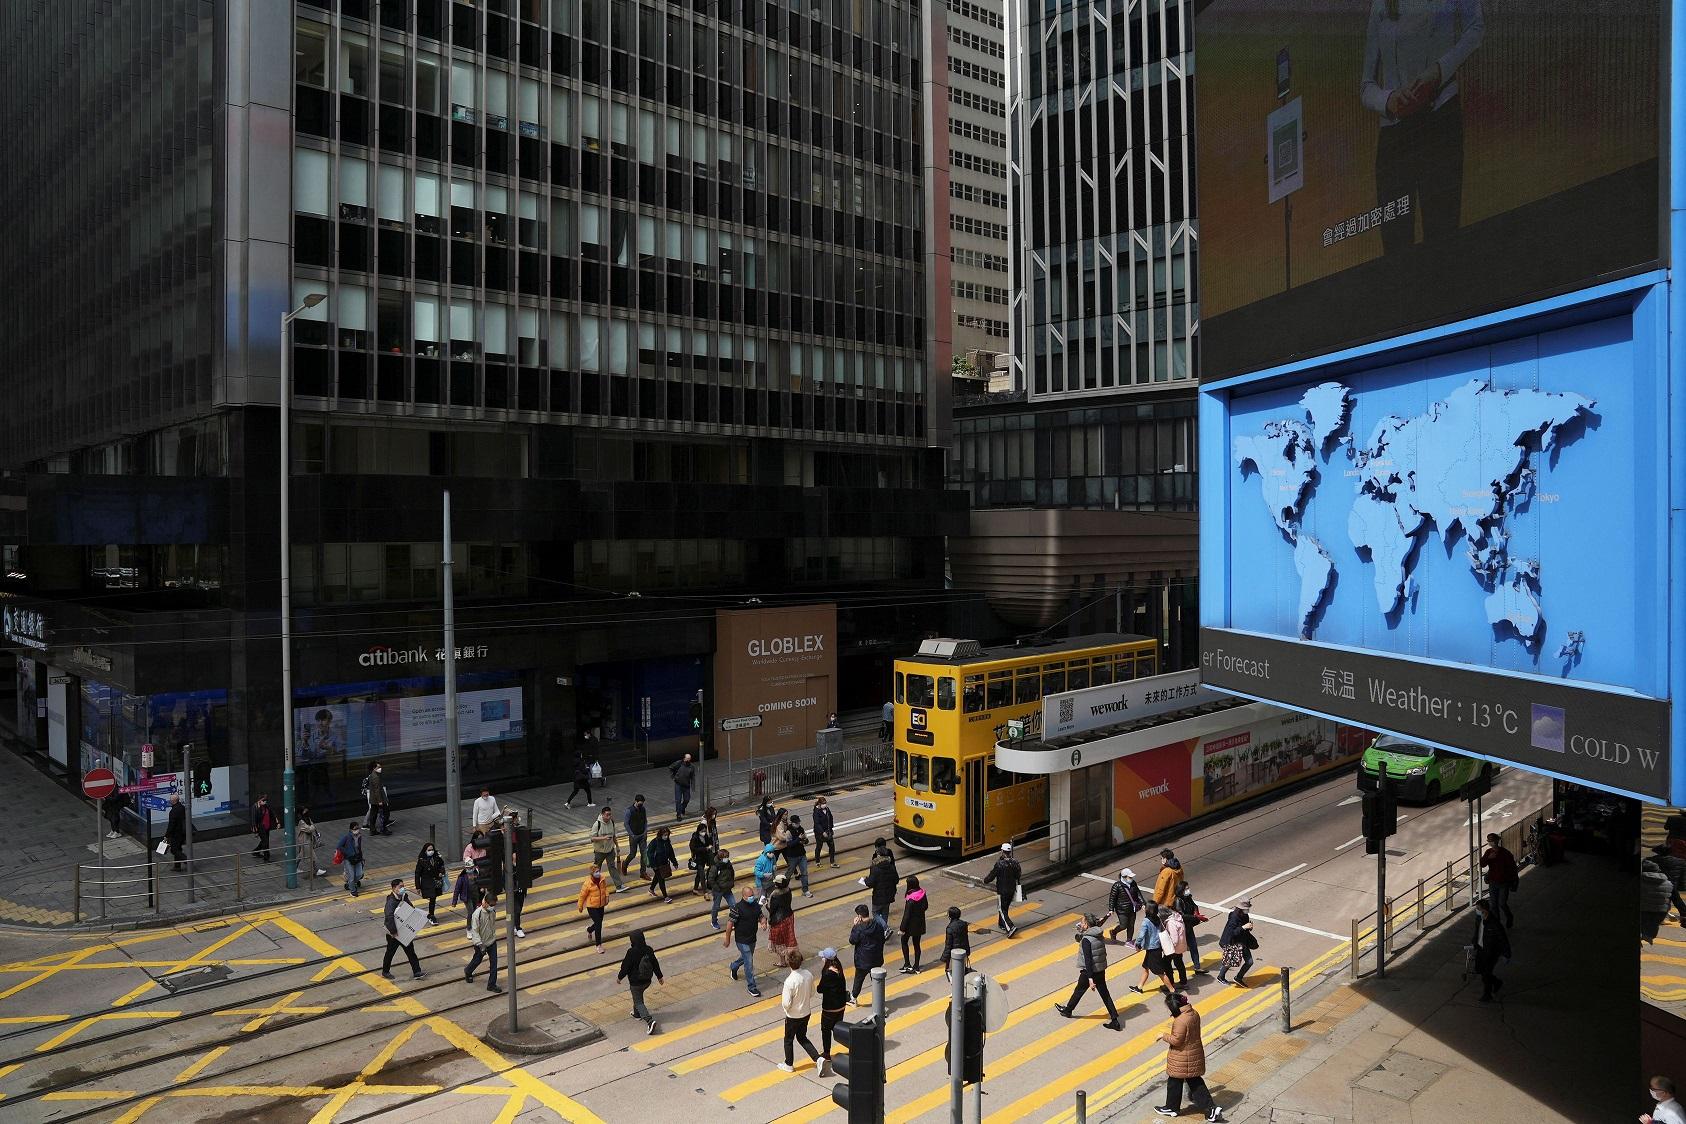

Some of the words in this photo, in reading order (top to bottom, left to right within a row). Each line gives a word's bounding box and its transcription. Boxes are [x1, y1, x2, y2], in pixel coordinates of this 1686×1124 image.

[1322, 194, 1410, 248] 會經過加密處理
[358, 646, 428, 666] citibank
[748, 634, 824, 657] GLOBLEX
[1217, 649, 1270, 679] Forecast
[758, 700, 793, 712] COMING
[794, 697, 817, 708] SOON
[1090, 694, 1129, 717] wework
[1144, 682, 1198, 705] 未來的工作方式
[1570, 734, 1631, 765] COLD
[1138, 778, 1169, 799] wework
